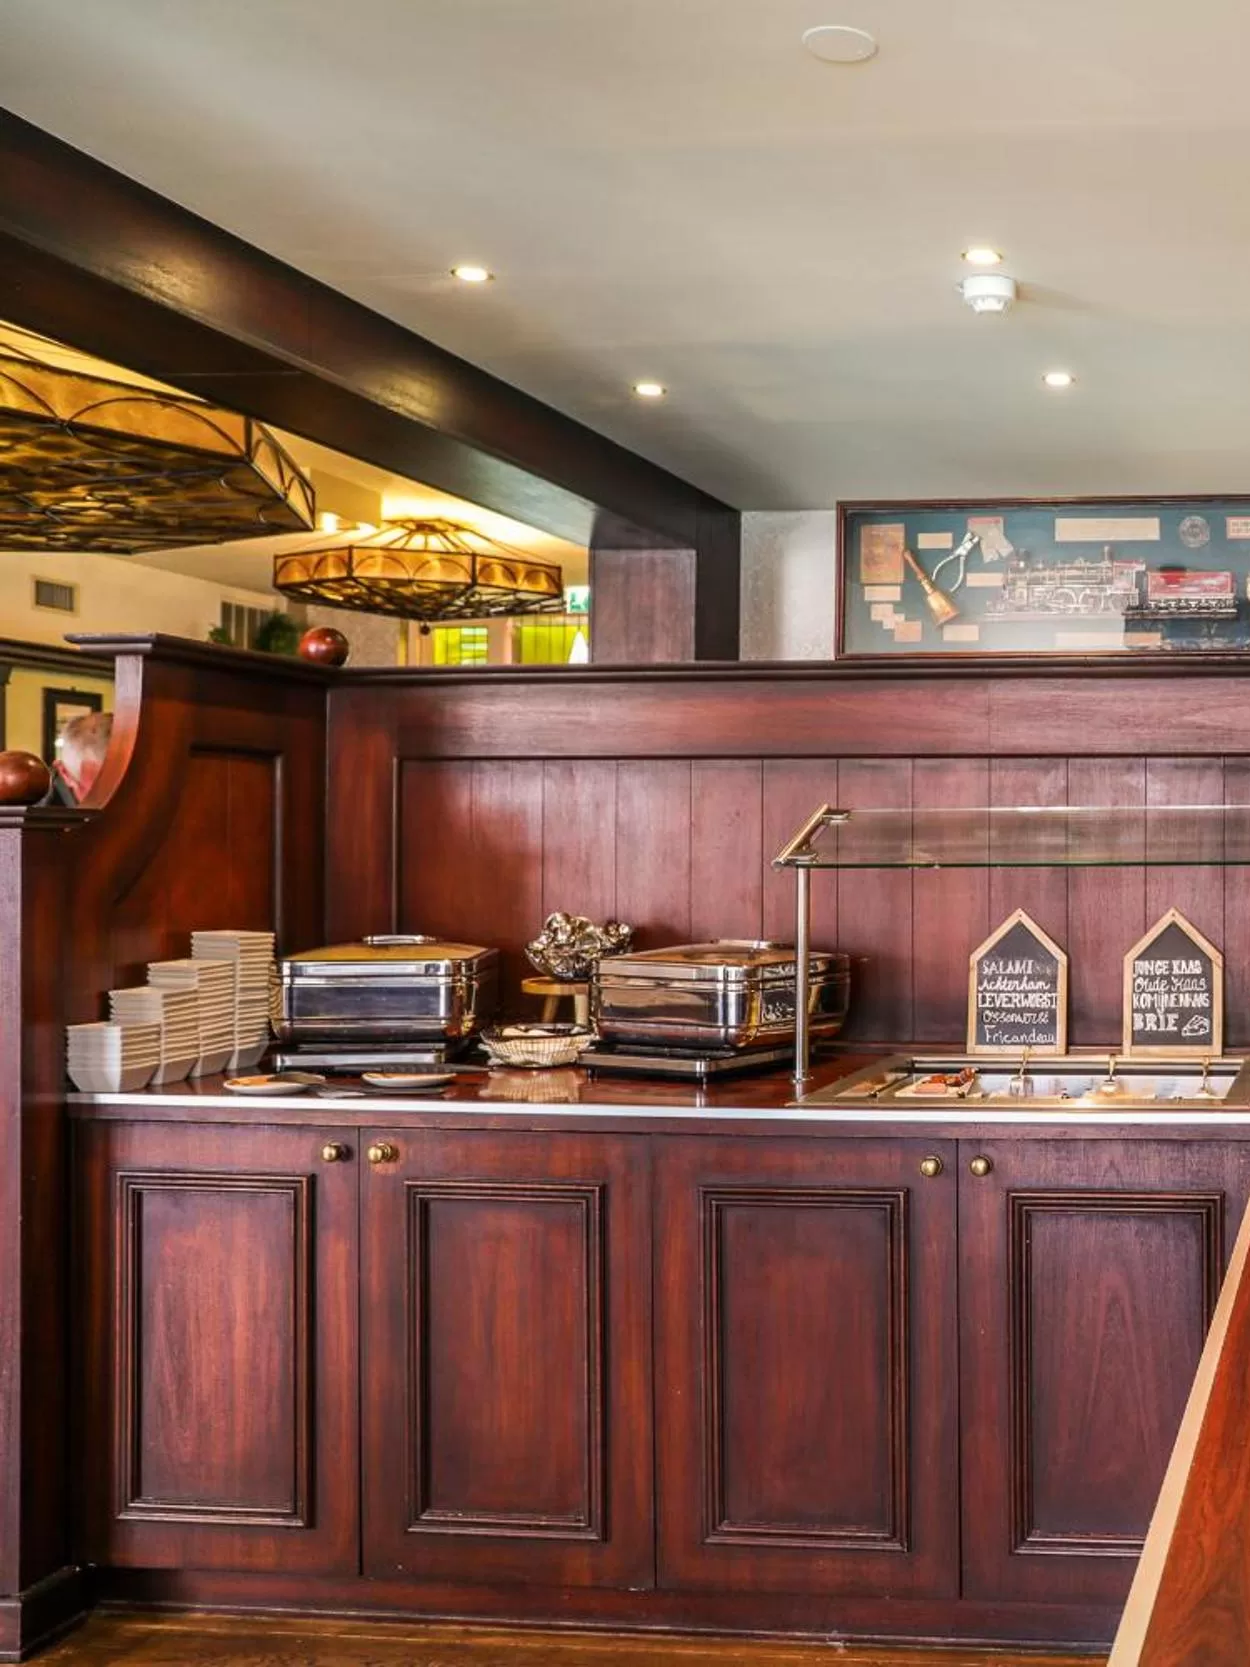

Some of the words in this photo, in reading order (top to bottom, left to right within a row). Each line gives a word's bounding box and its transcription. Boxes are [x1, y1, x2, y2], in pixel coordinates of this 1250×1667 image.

[982, 959, 1034, 975] SALAMI
[1172, 960, 1202, 975] KAAS
[1133, 1012, 1179, 1031] BRIE
[984, 1024, 1055, 1044] Fricandeau
